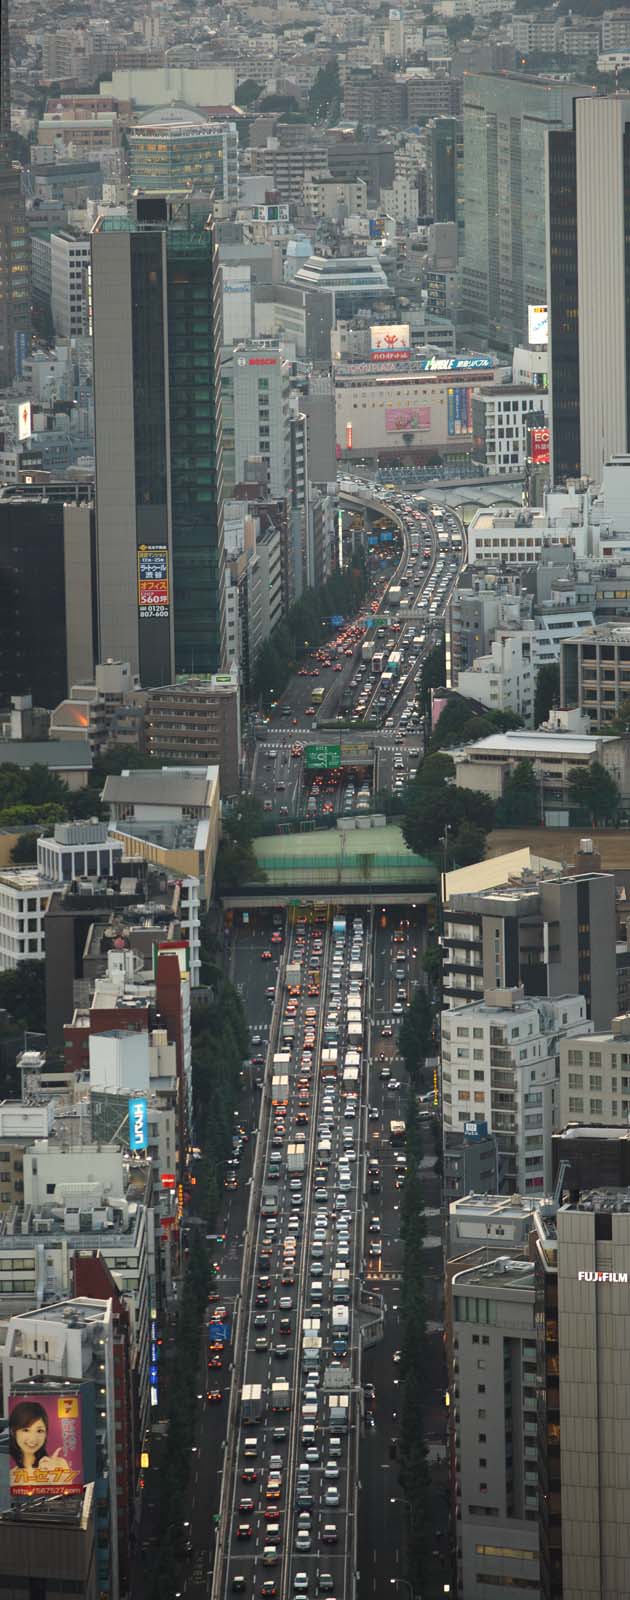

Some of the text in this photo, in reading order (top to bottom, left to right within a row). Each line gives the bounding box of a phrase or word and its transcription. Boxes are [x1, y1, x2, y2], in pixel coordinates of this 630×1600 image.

[141, 582, 166, 590] オフィス
[141, 596, 167, 604] 560坪
[578, 1271, 627, 1282] FUJIFILM
[13, 1467, 80, 1483] カーセブン
